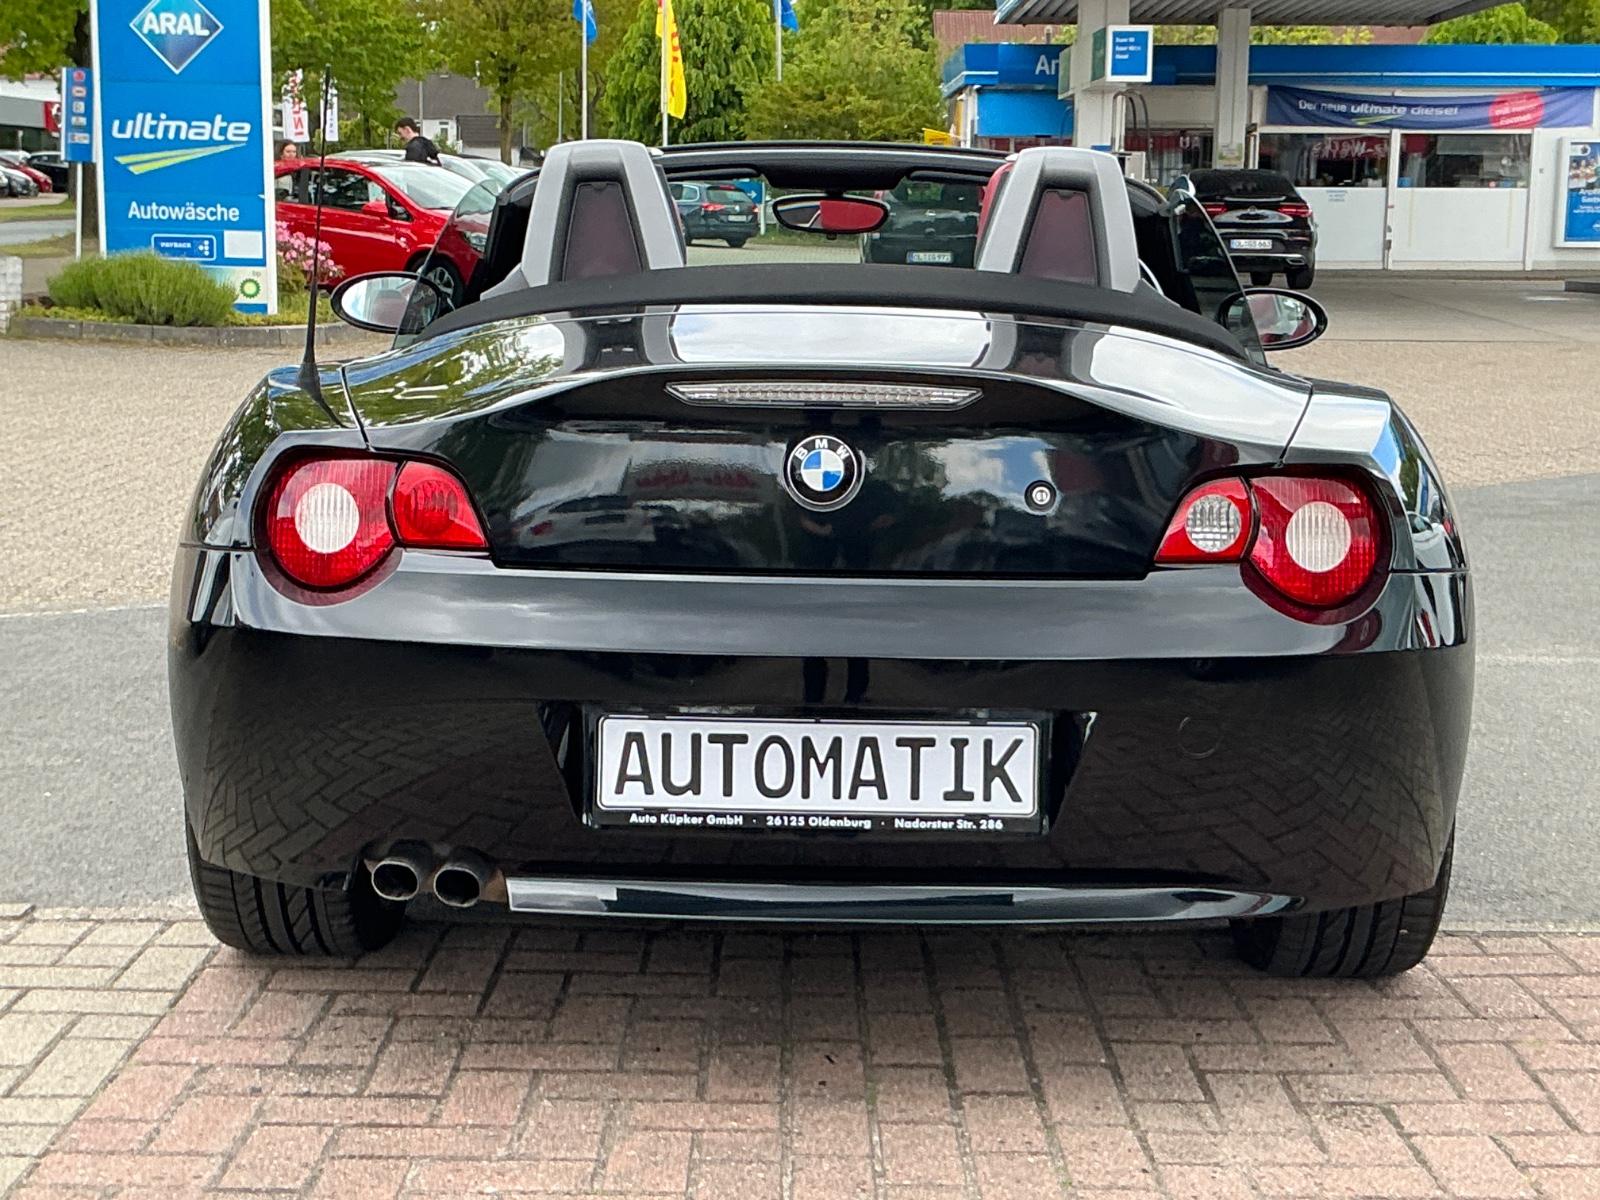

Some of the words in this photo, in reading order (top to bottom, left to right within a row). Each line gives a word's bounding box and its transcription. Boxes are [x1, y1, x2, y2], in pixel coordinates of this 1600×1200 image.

[143, 12, 210, 36] ARAL
[1298, 100, 1316, 110] Der
[1320, 103, 1347, 113] neue
[1351, 104, 1408, 115] ultimate
[1411, 106, 1459, 116] diesel
[112, 112, 252, 141] ultimate
[128, 201, 240, 222] Autowäsche
[795, 438, 850, 461] BMW
[615, 731, 1024, 803] AUTOMATIK
[629, 813, 657, 825] Auto
[660, 813, 704, 827] Küpker
[706, 814, 743, 827] GmbH
[766, 815, 804, 827] 26125
[808, 816, 872, 830] Oldenburg
[894, 818, 955, 830] Nadorster
[956, 819, 977, 831] Str.
[980, 819, 1003, 831] 286
